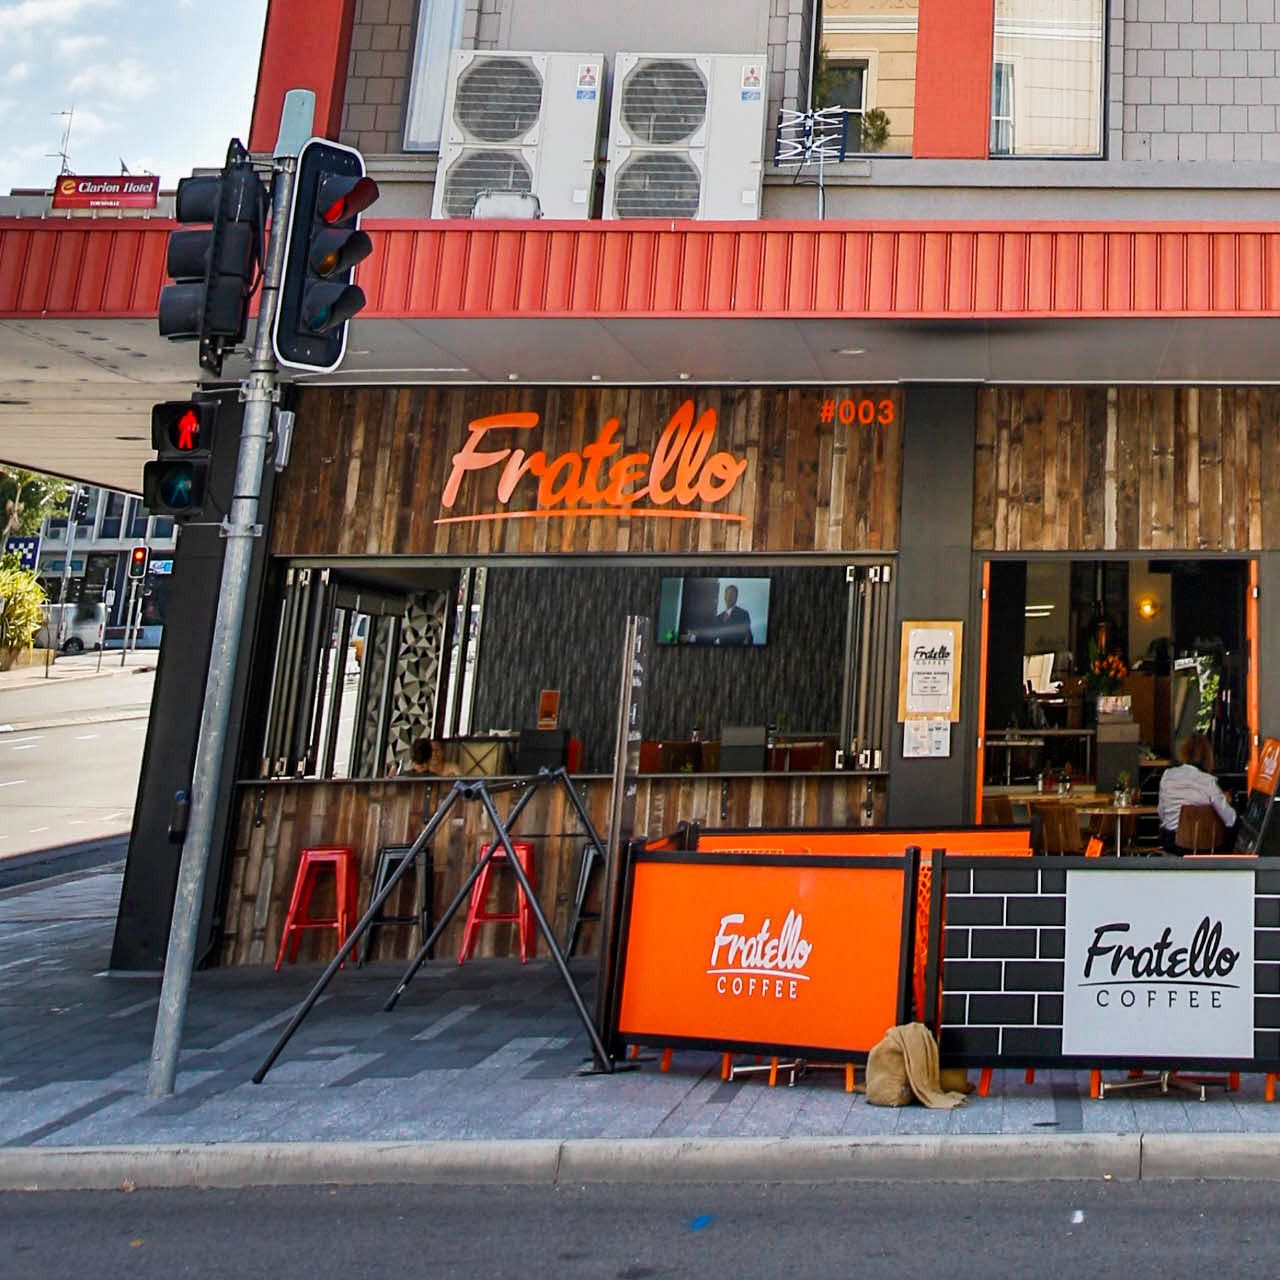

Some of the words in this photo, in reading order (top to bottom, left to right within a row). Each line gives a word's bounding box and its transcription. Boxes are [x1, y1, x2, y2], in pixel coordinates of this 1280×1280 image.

[78, 182, 119, 193] Clarion
[123, 182, 153, 193] Hotel
[820, 399, 895, 424] #003
[441, 399, 747, 508] Fratello
[913, 644, 950, 660] Fratello
[711, 909, 813, 969] Fratello
[1084, 916, 1240, 978] Fratello
[717, 976, 797, 999] COFFEE
[1096, 990, 1222, 1008] COFFEE
